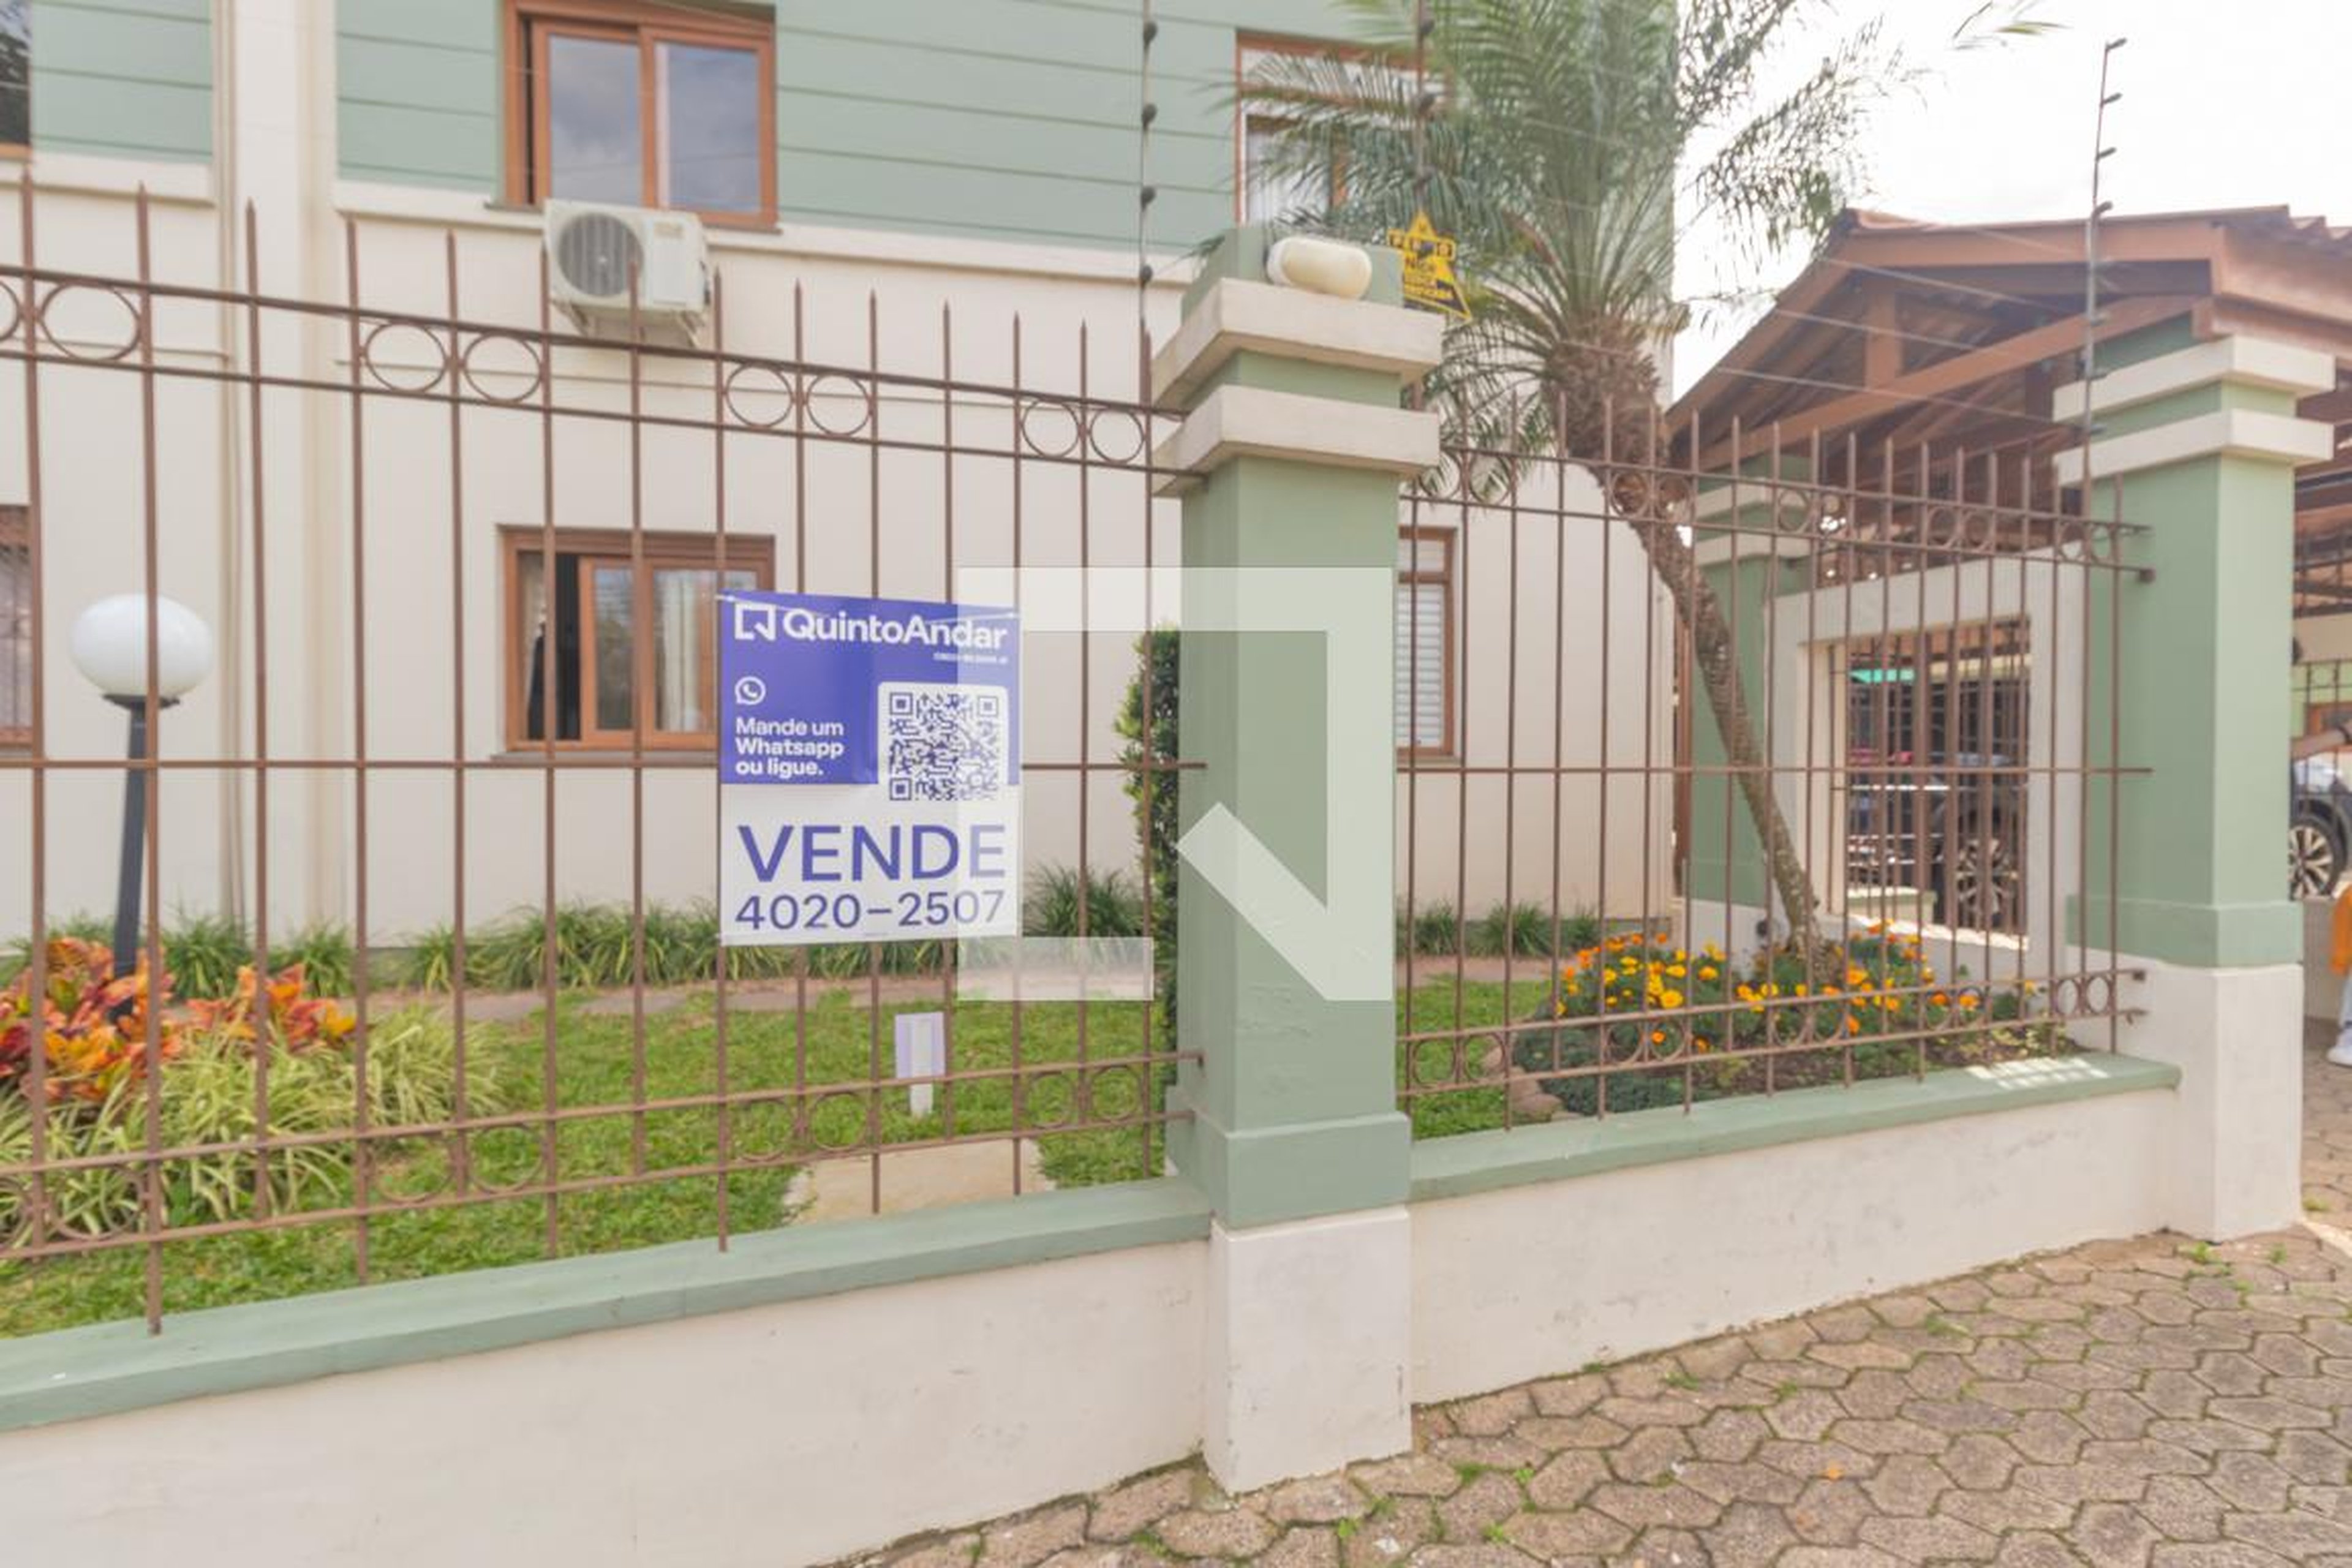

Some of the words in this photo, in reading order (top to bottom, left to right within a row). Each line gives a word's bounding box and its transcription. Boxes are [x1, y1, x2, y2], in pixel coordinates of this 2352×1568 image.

[783, 608, 1008, 649] QuintoAndar
[736, 717, 807, 736] Mande
[812, 721, 844, 736] um
[736, 738, 844, 760] Whatsapp
[736, 761, 762, 775] ou
[767, 759, 824, 779] ligue.
[737, 824, 1006, 882] VENDE
[735, 890, 1005, 930] 4020-2507
